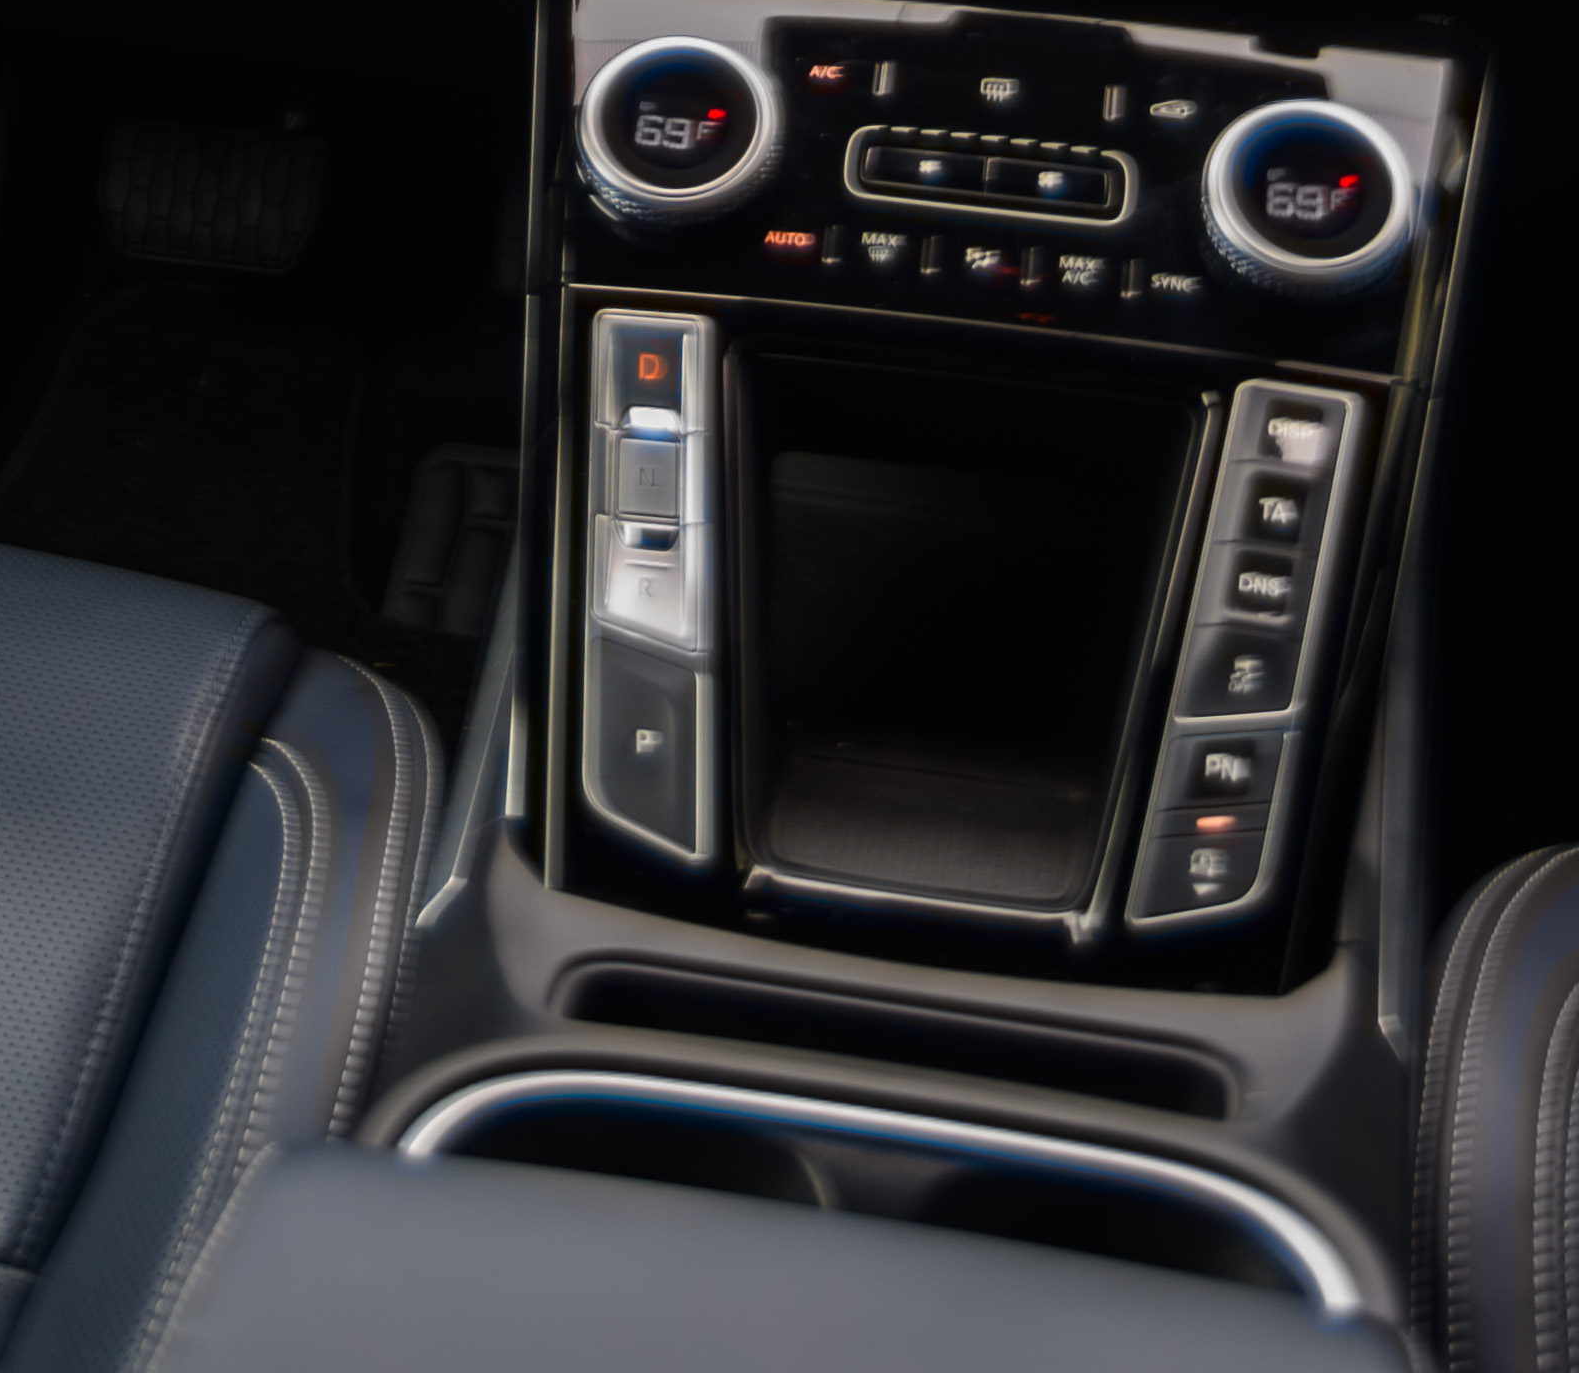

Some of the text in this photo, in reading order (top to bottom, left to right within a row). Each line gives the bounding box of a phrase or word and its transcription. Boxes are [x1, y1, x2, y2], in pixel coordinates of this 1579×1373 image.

[809, 65, 844, 80] A/C
[764, 230, 815, 246] AUTO
[861, 232, 905, 247] MAX
[1059, 255, 1104, 270] MAX
[1062, 270, 1097, 285] A/C
[1151, 273, 1201, 292] SYNC
[638, 353, 665, 380] D
[639, 467, 656, 488] N
[1259, 497, 1298, 524] TA
[637, 576, 654, 598] R
[1238, 572, 1291, 597] DNS
[636, 729, 659, 753] P
